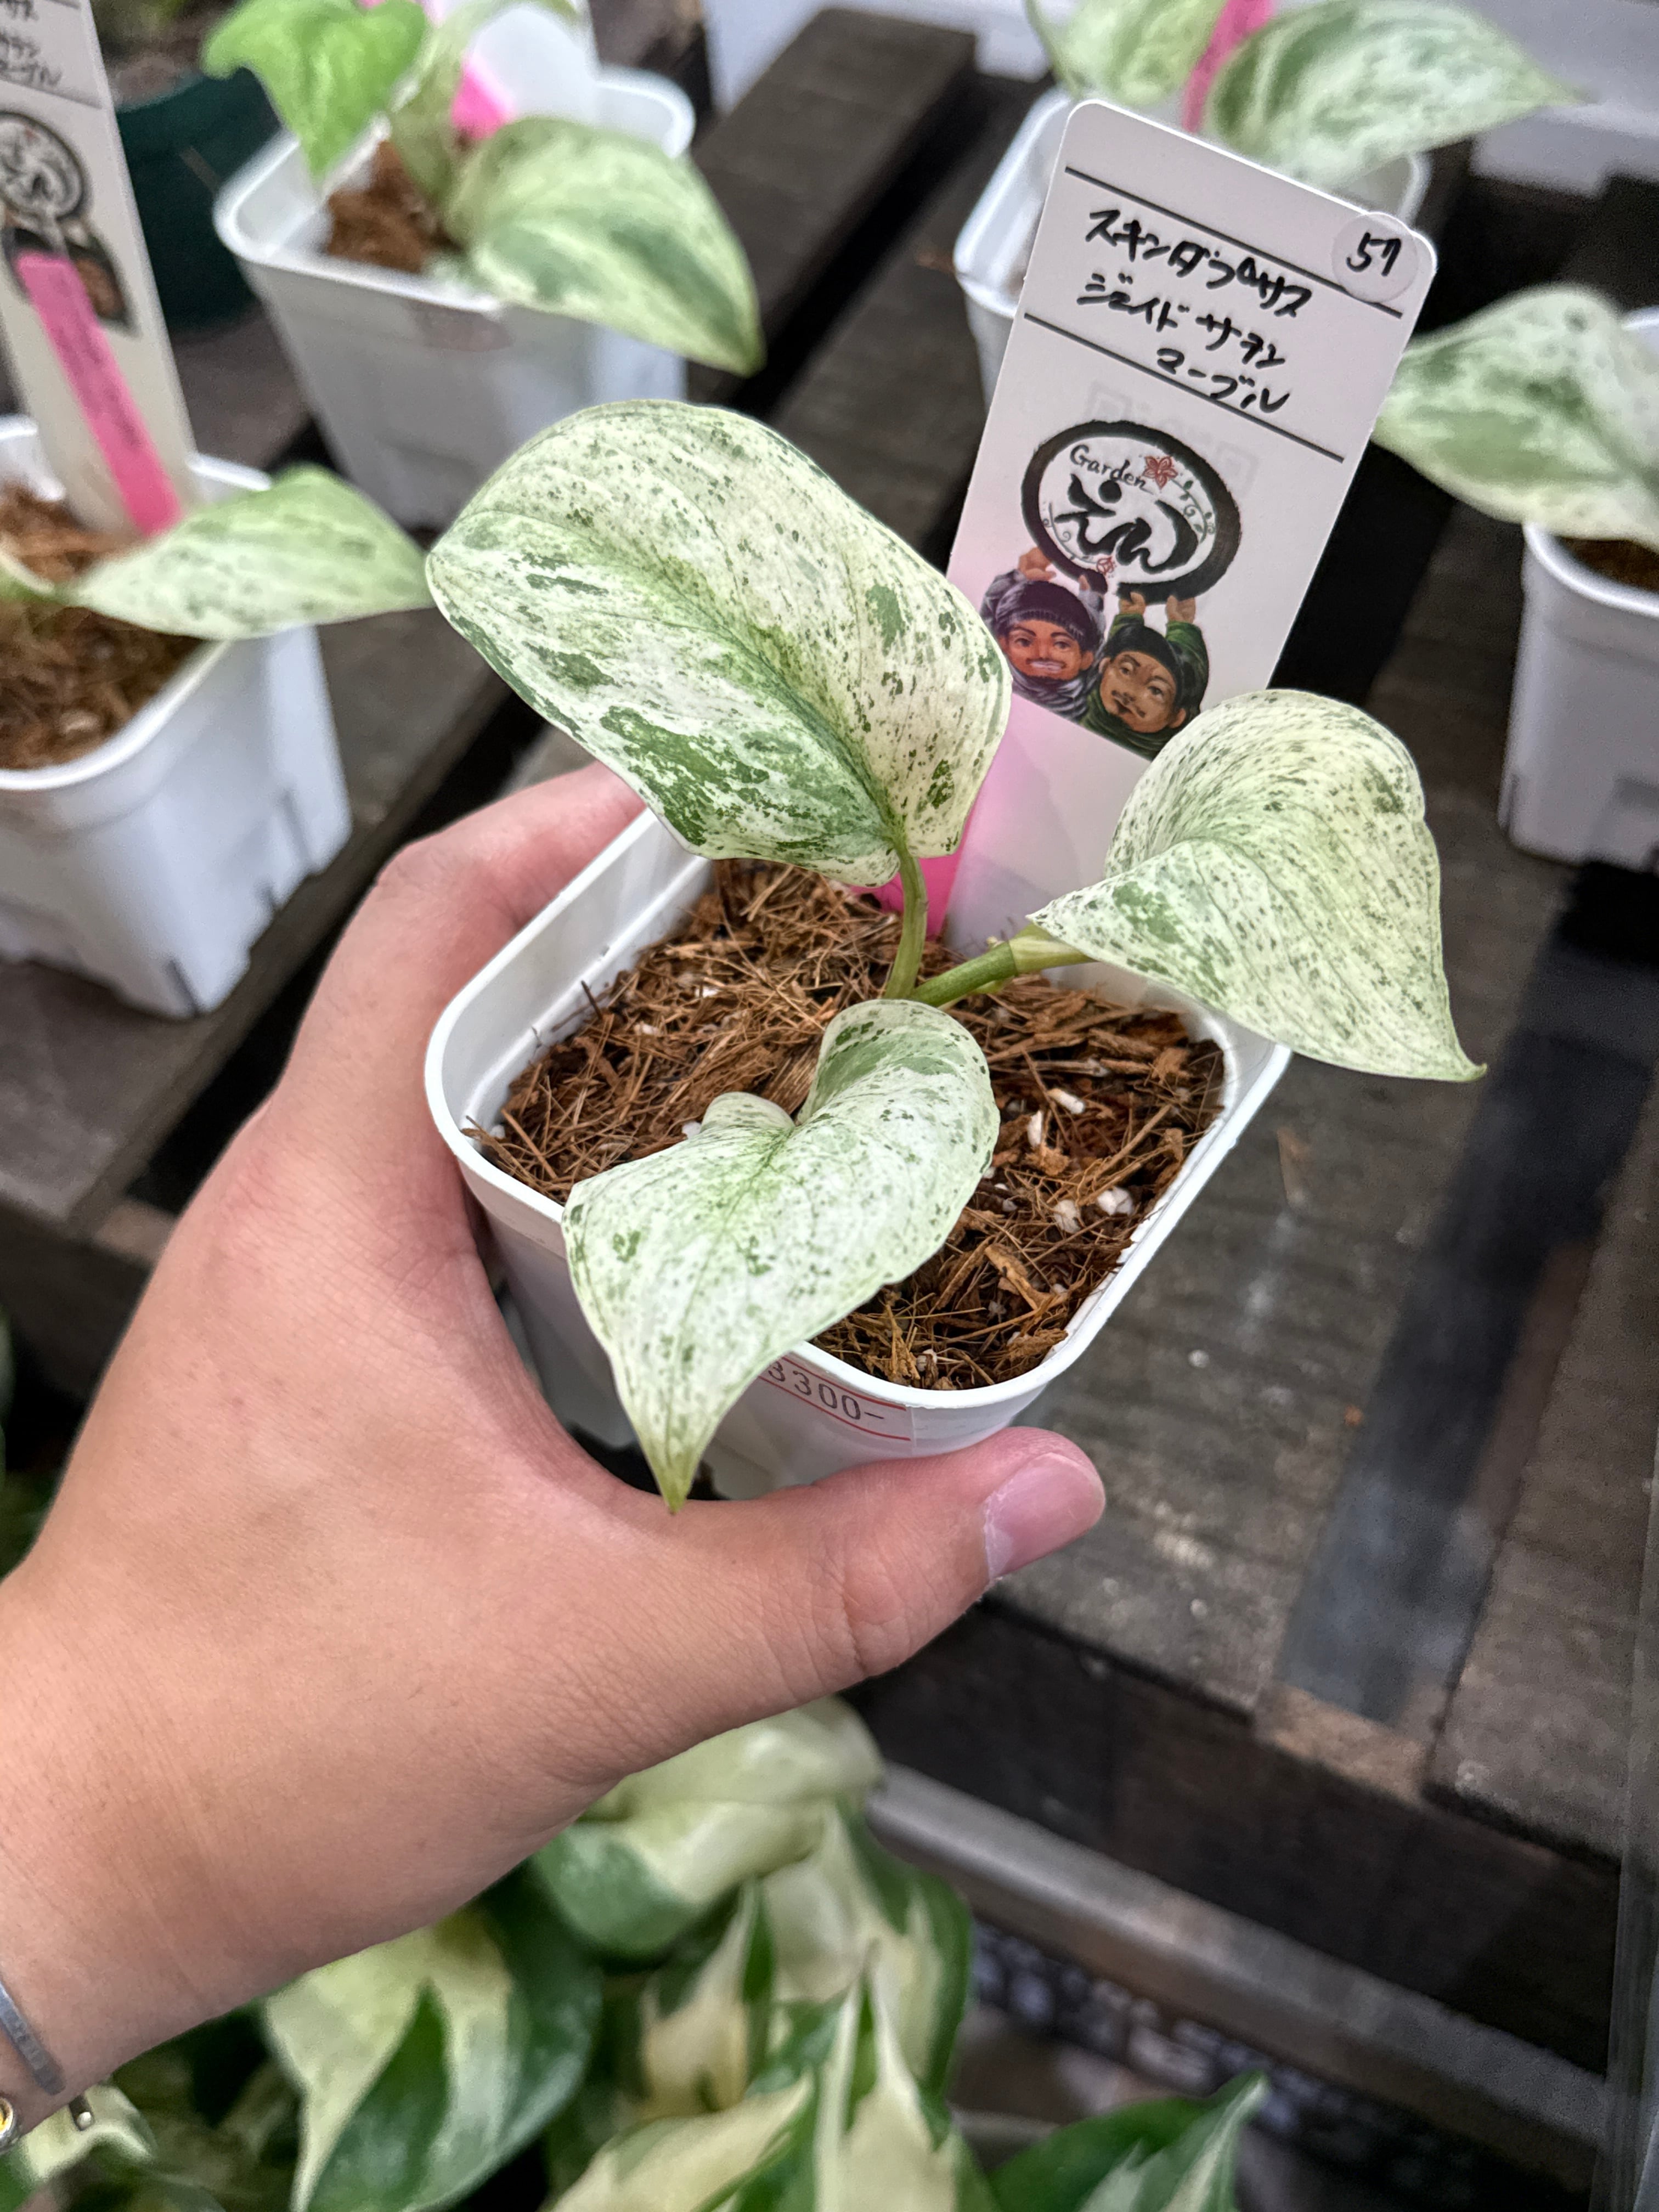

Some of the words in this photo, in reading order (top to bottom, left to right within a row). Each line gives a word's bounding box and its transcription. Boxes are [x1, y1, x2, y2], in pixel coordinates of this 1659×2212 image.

[1076, 272, 1190, 332] ジェイド
[1195, 314, 1286, 369] サテン
[1156, 347, 1291, 413] マーブル
[1070, 444, 1153, 495] Garden
